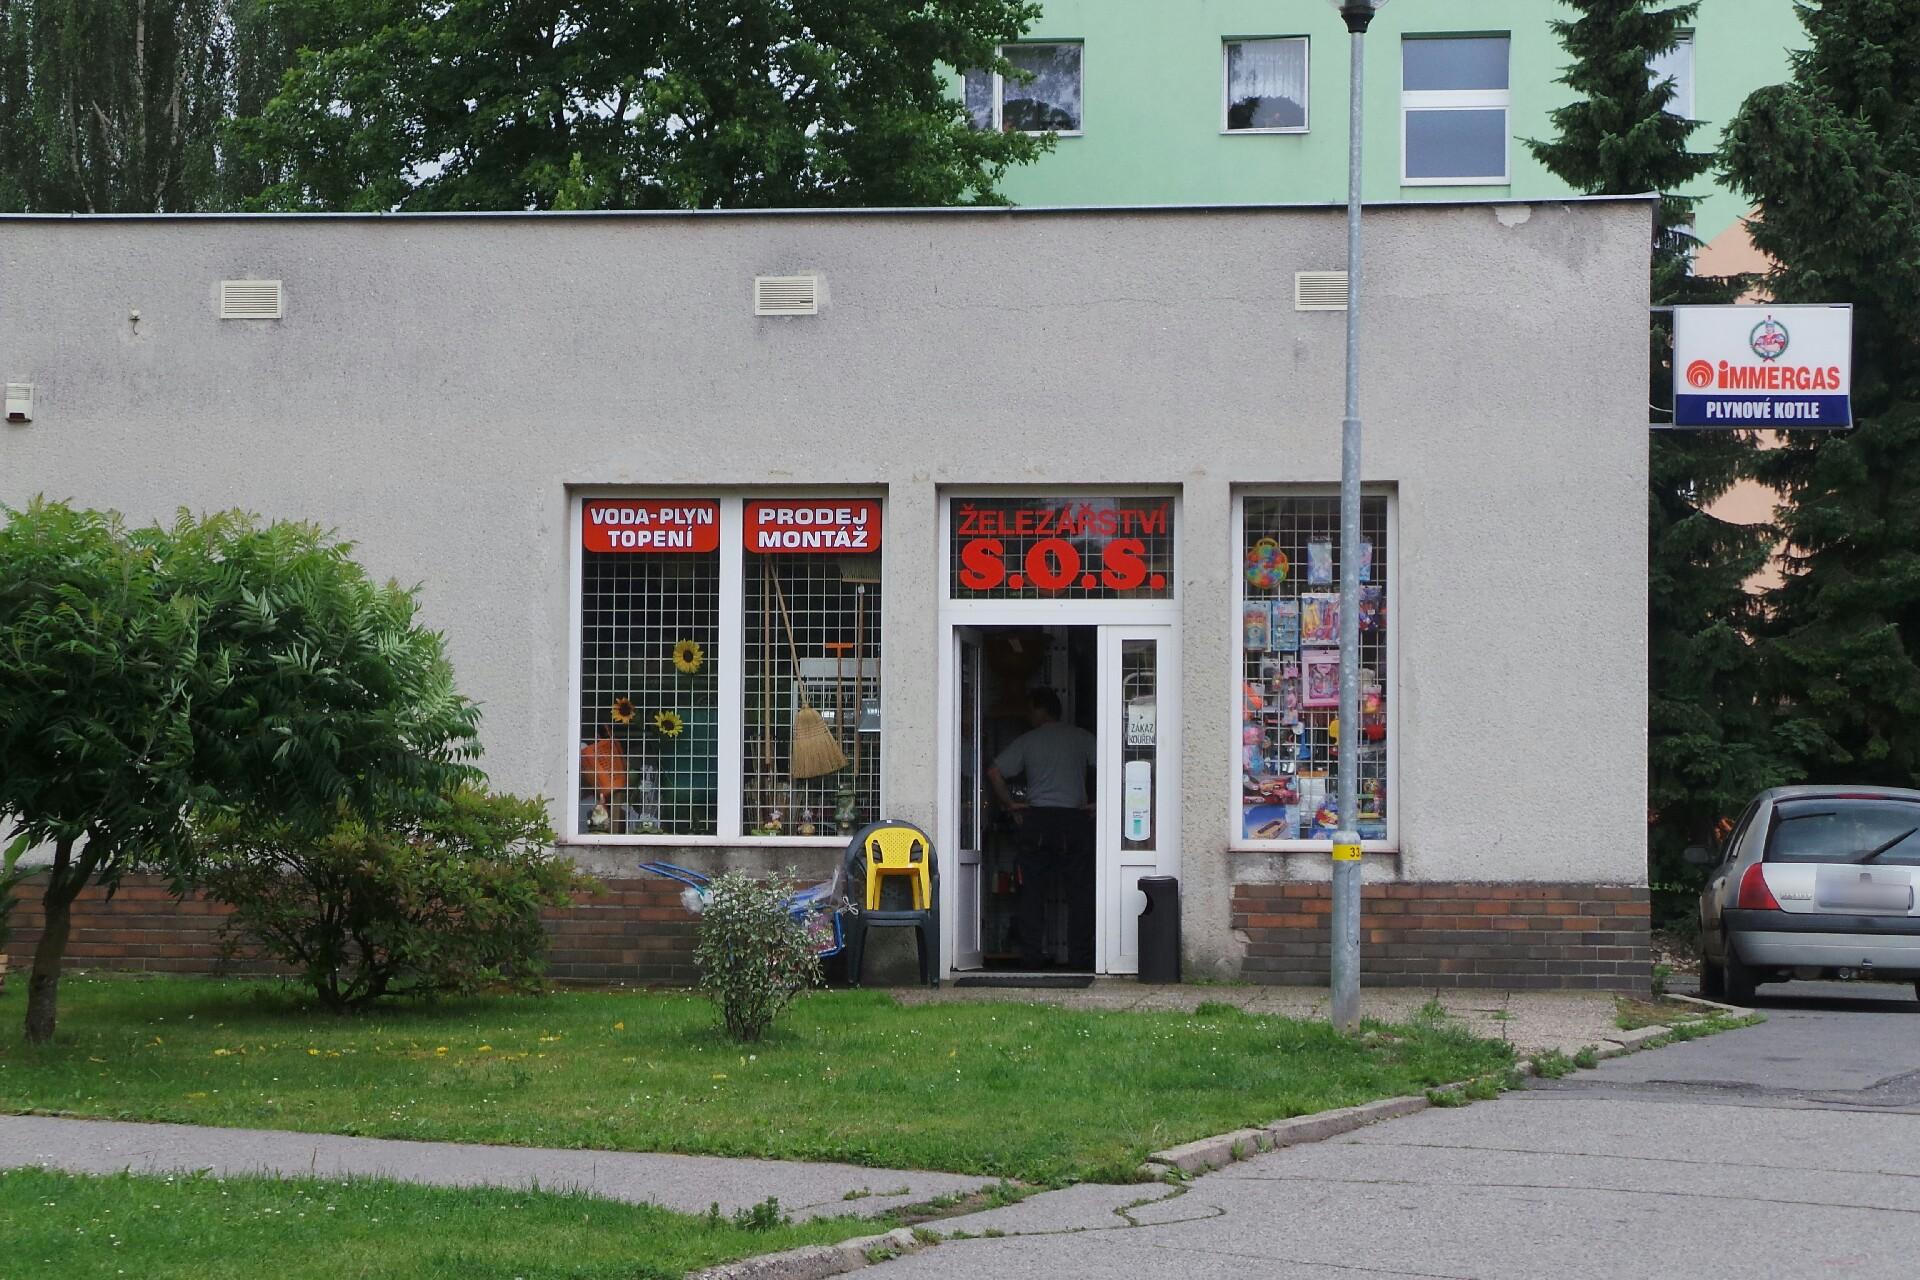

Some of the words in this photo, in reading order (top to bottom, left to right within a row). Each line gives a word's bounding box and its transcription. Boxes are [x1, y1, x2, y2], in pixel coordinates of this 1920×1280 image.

[1706, 398, 1770, 418] PLYNOVÉ
[1774, 402, 1820, 418] KOTLE
[590, 508, 713, 526] VODA-PLYN
[758, 508, 868, 526] PRODEJ
[958, 503, 1169, 535] ŽELEZÁŘSTVÍ
[607, 526, 693, 548] TOPENÍ
[758, 527, 868, 548] MONTÁŽ
[960, 538, 1166, 590] S.O.S.
